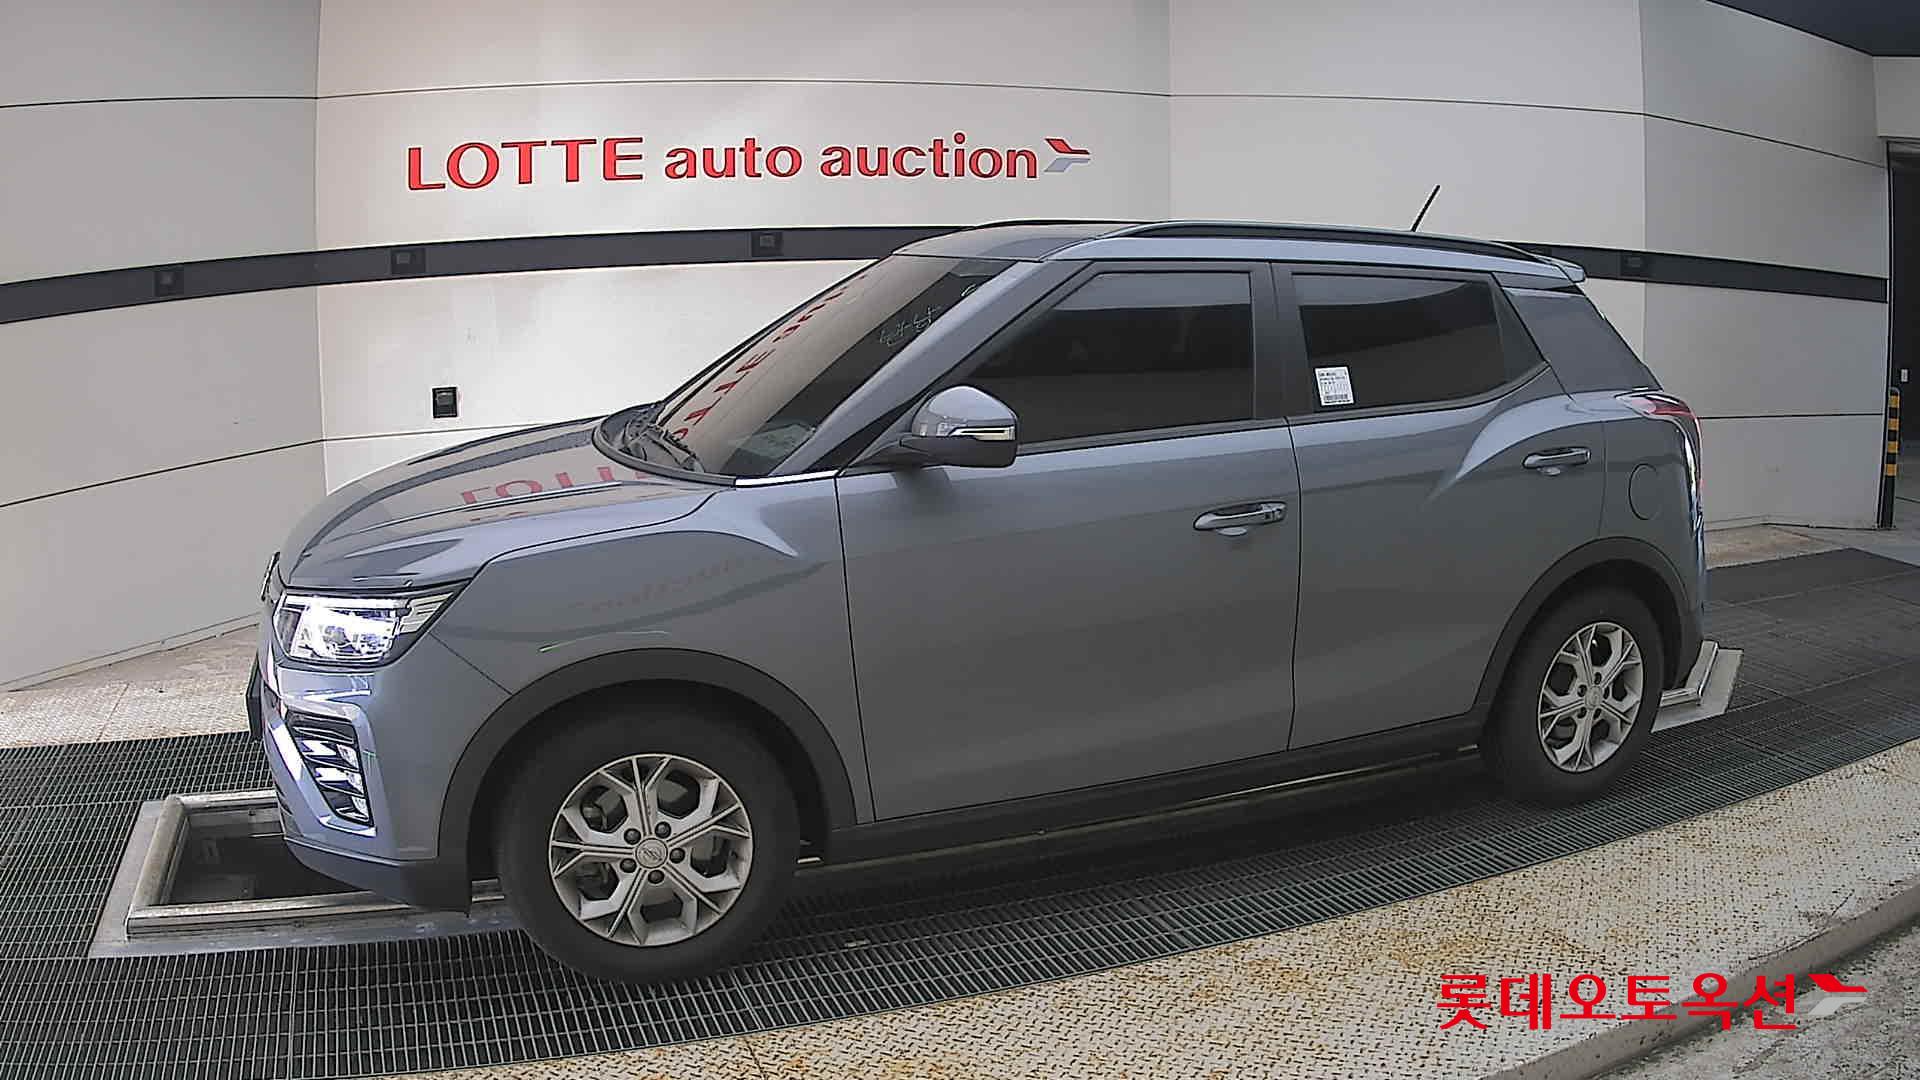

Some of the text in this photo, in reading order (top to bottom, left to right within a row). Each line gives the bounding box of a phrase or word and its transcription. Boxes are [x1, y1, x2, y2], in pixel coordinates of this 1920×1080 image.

[407, 132, 1039, 191] LOTTE auto auction
